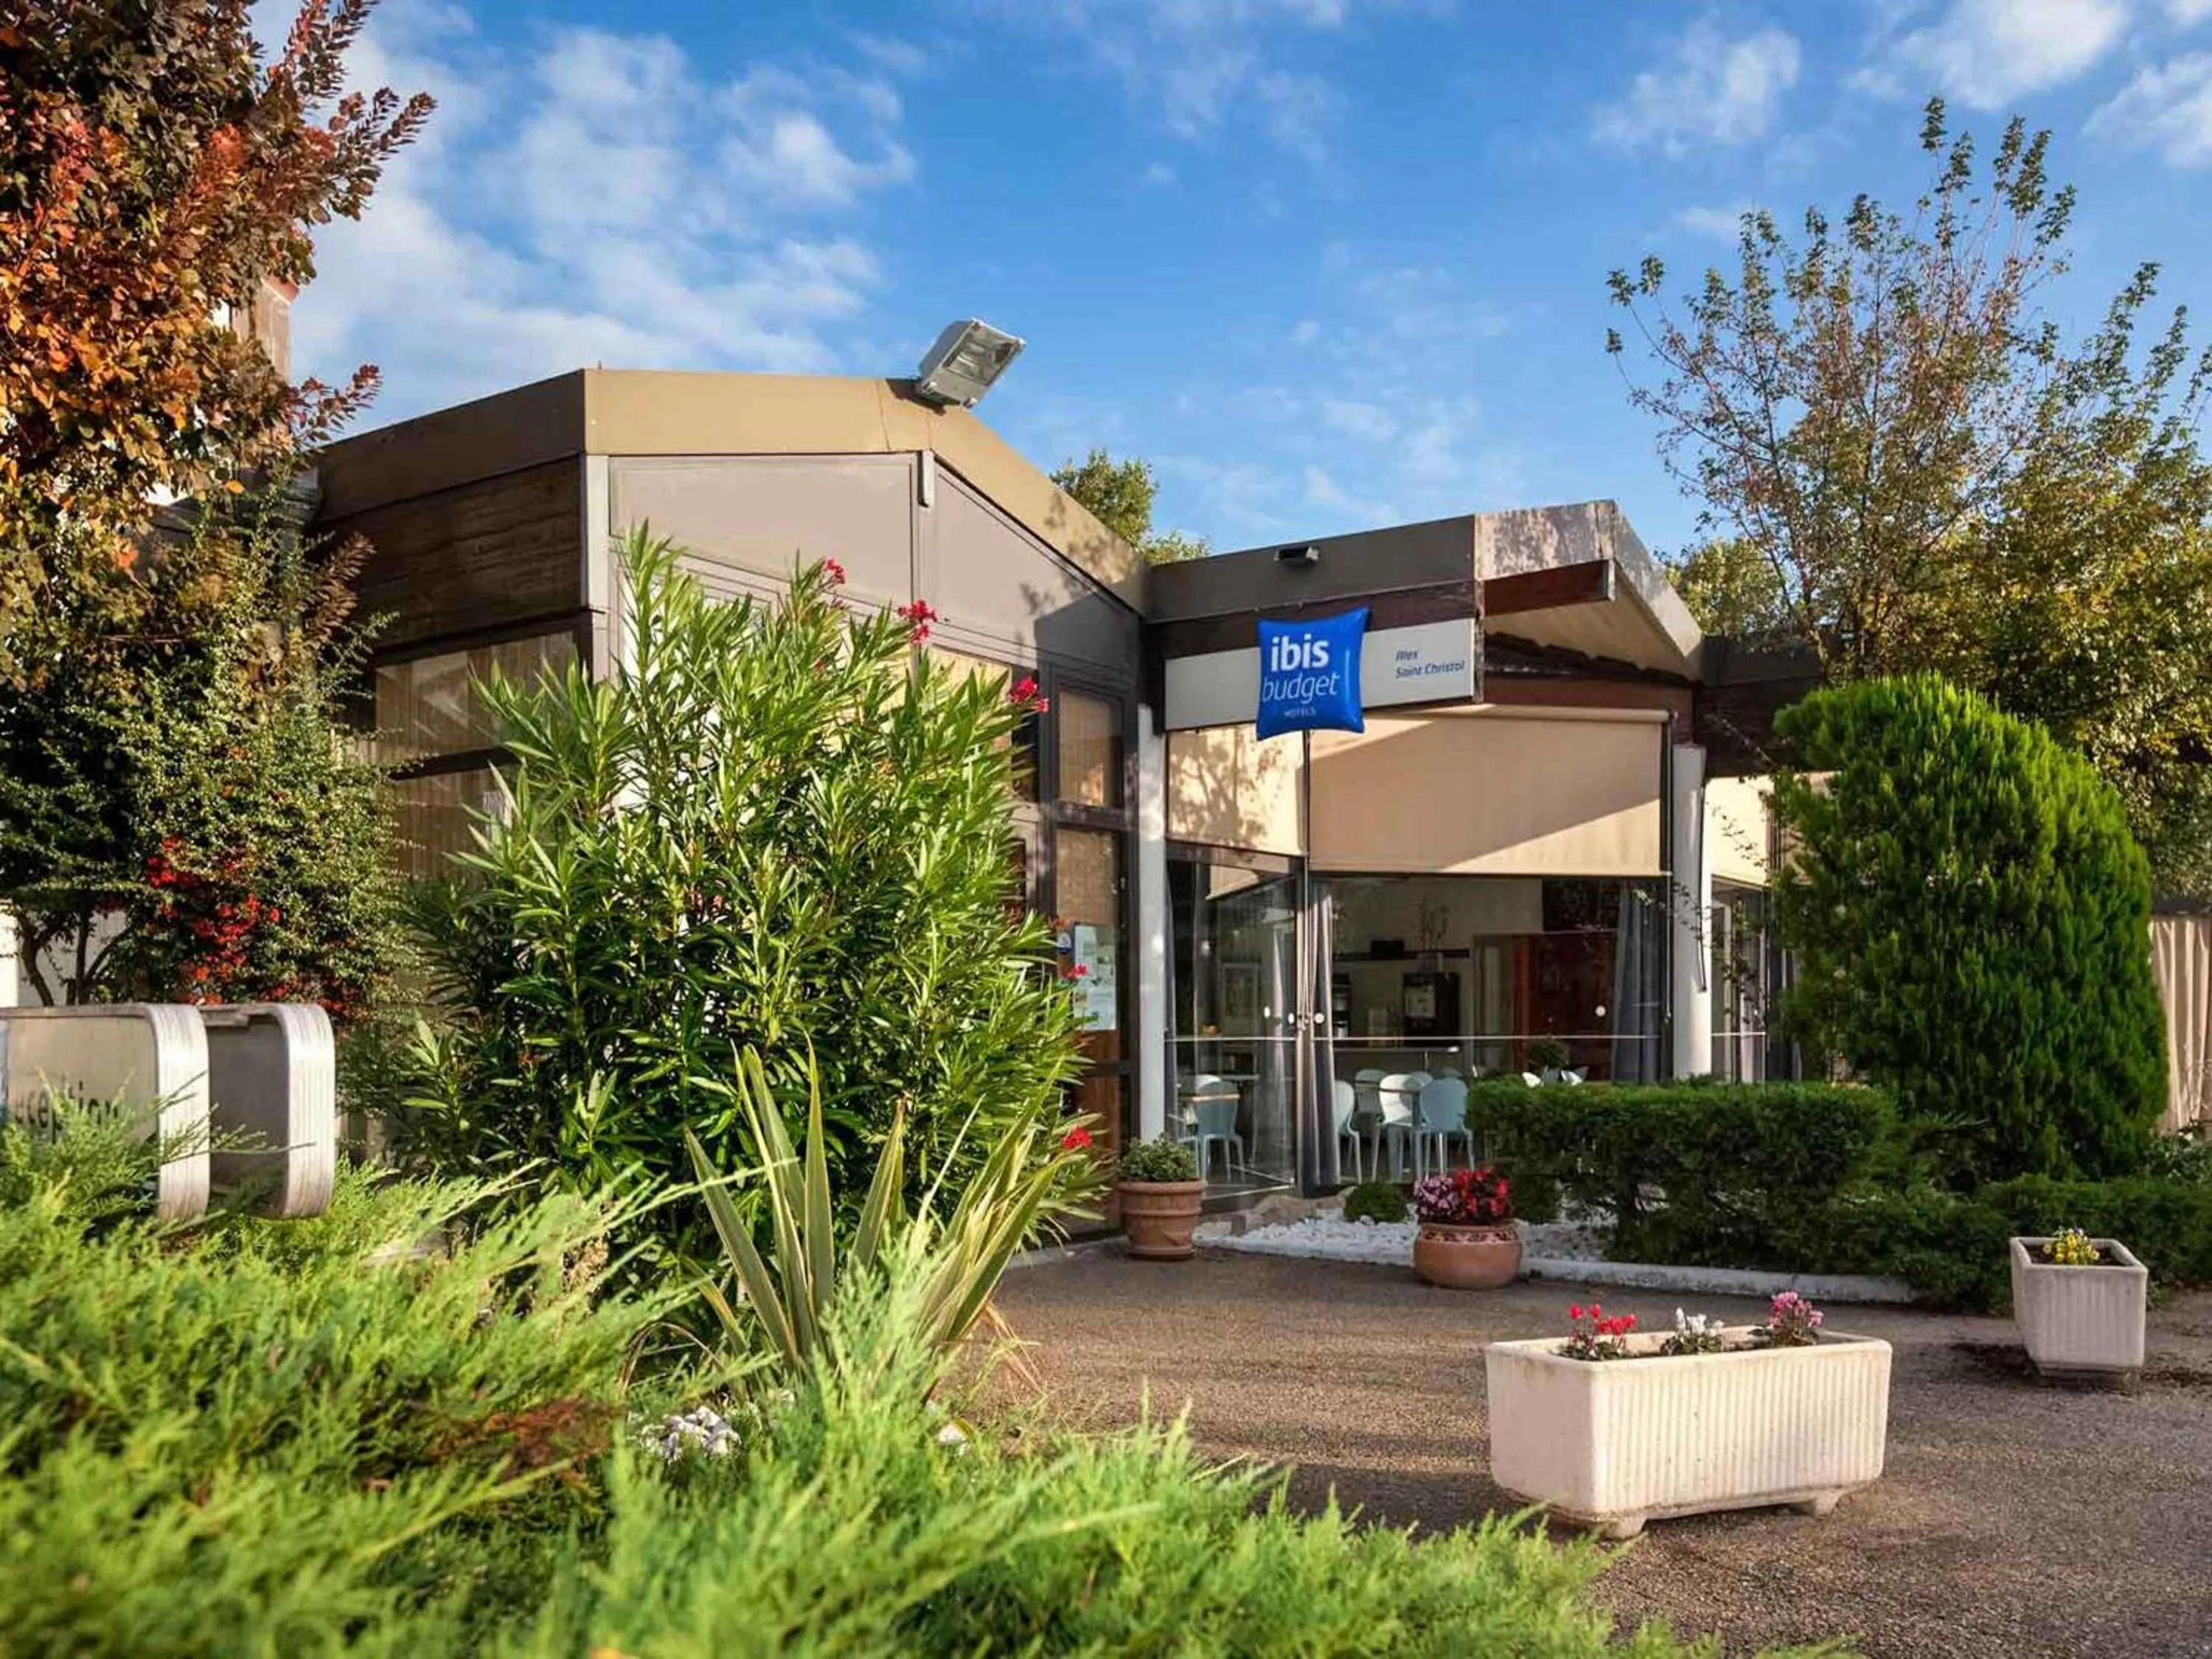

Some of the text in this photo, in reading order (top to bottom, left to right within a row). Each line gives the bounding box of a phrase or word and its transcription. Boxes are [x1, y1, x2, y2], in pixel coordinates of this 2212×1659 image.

[1271, 633, 1329, 672] ibis
[1395, 659, 1465, 679] Saint Christol
[1262, 672, 1340, 704] budget
